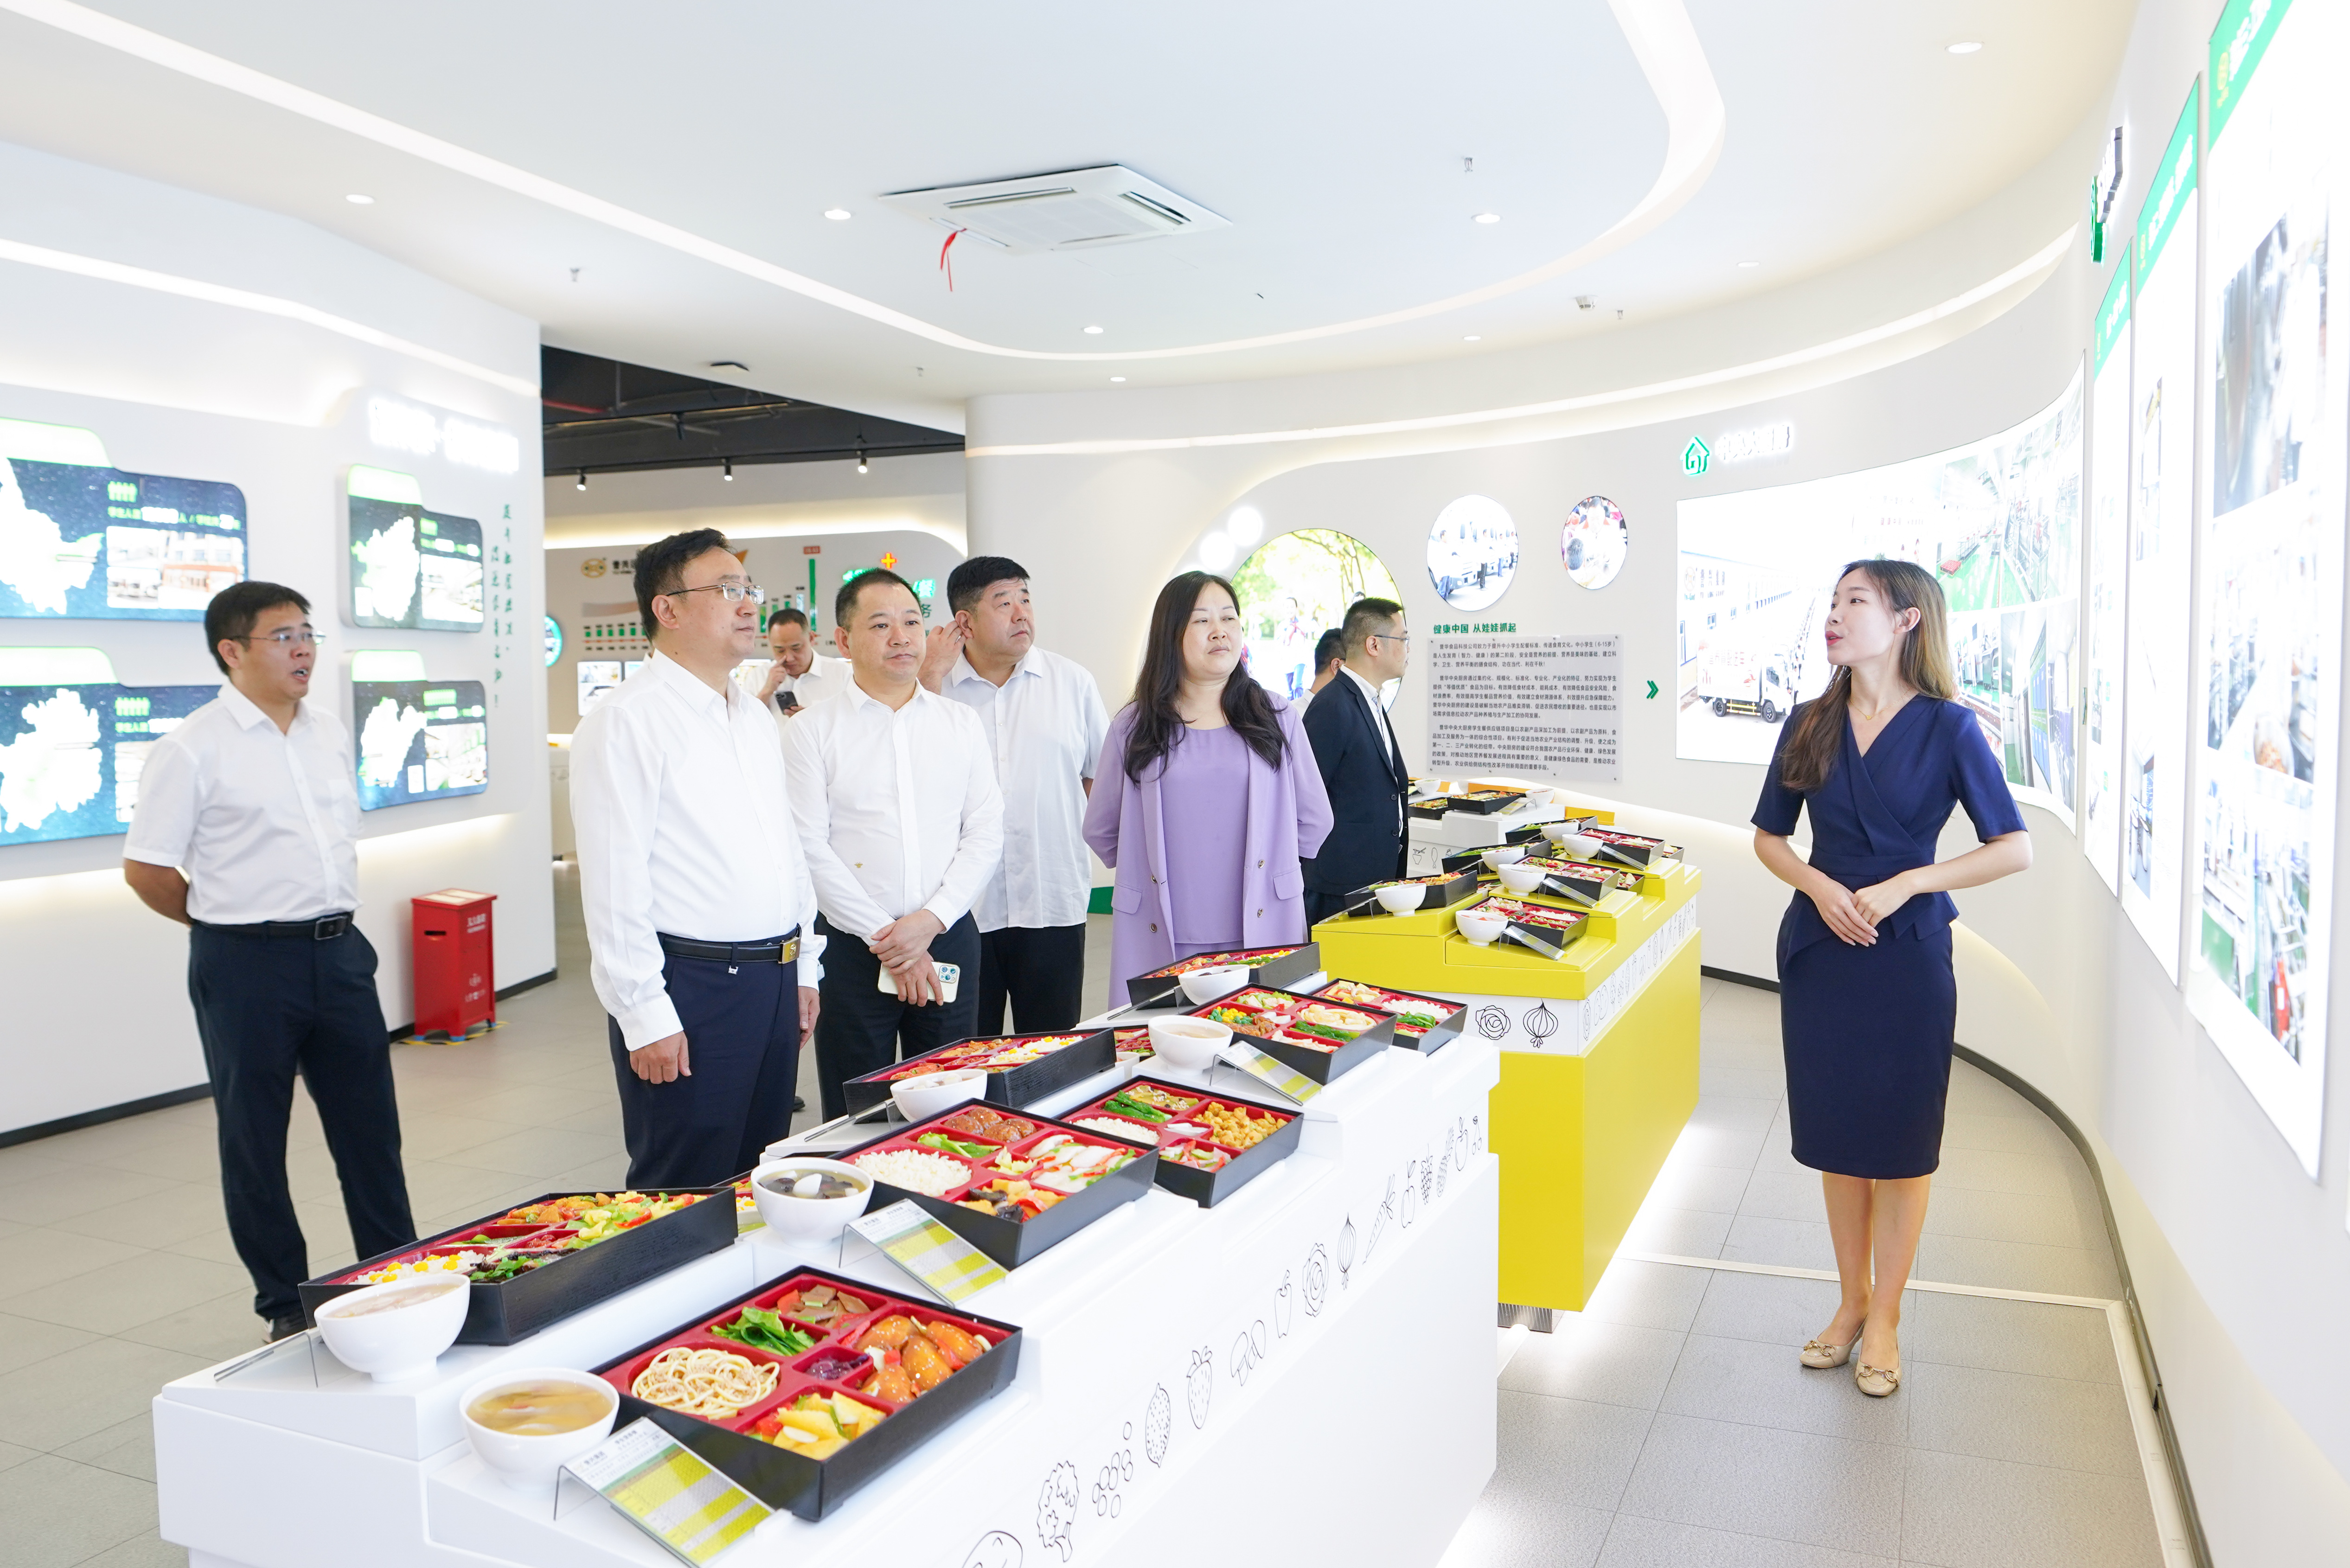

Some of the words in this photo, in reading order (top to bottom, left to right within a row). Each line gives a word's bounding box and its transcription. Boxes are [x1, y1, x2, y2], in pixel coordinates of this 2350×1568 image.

[1434, 624, 1468, 634] 健康中国
[1473, 623, 1516, 633] 从娃娃抓起
